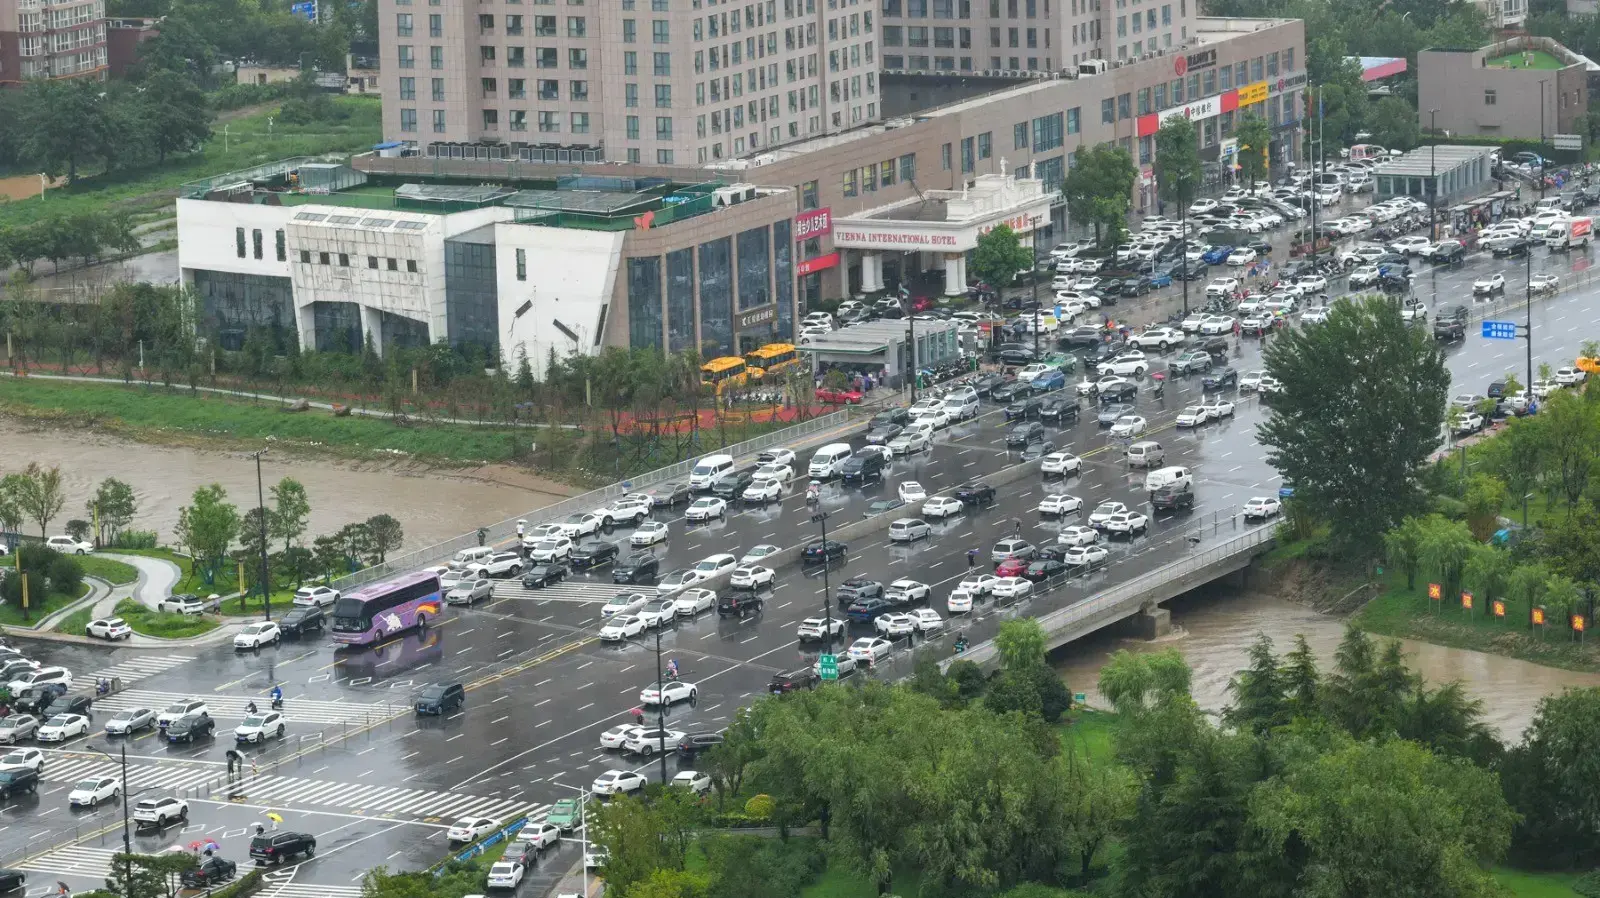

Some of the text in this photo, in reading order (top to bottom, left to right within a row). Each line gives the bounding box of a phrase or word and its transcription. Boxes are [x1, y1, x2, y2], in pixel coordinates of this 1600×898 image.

[796, 213, 828, 237] 视台少儿艺术团
[836, 231, 957, 246] VIENNA INTERNATIONAL HOTEL
